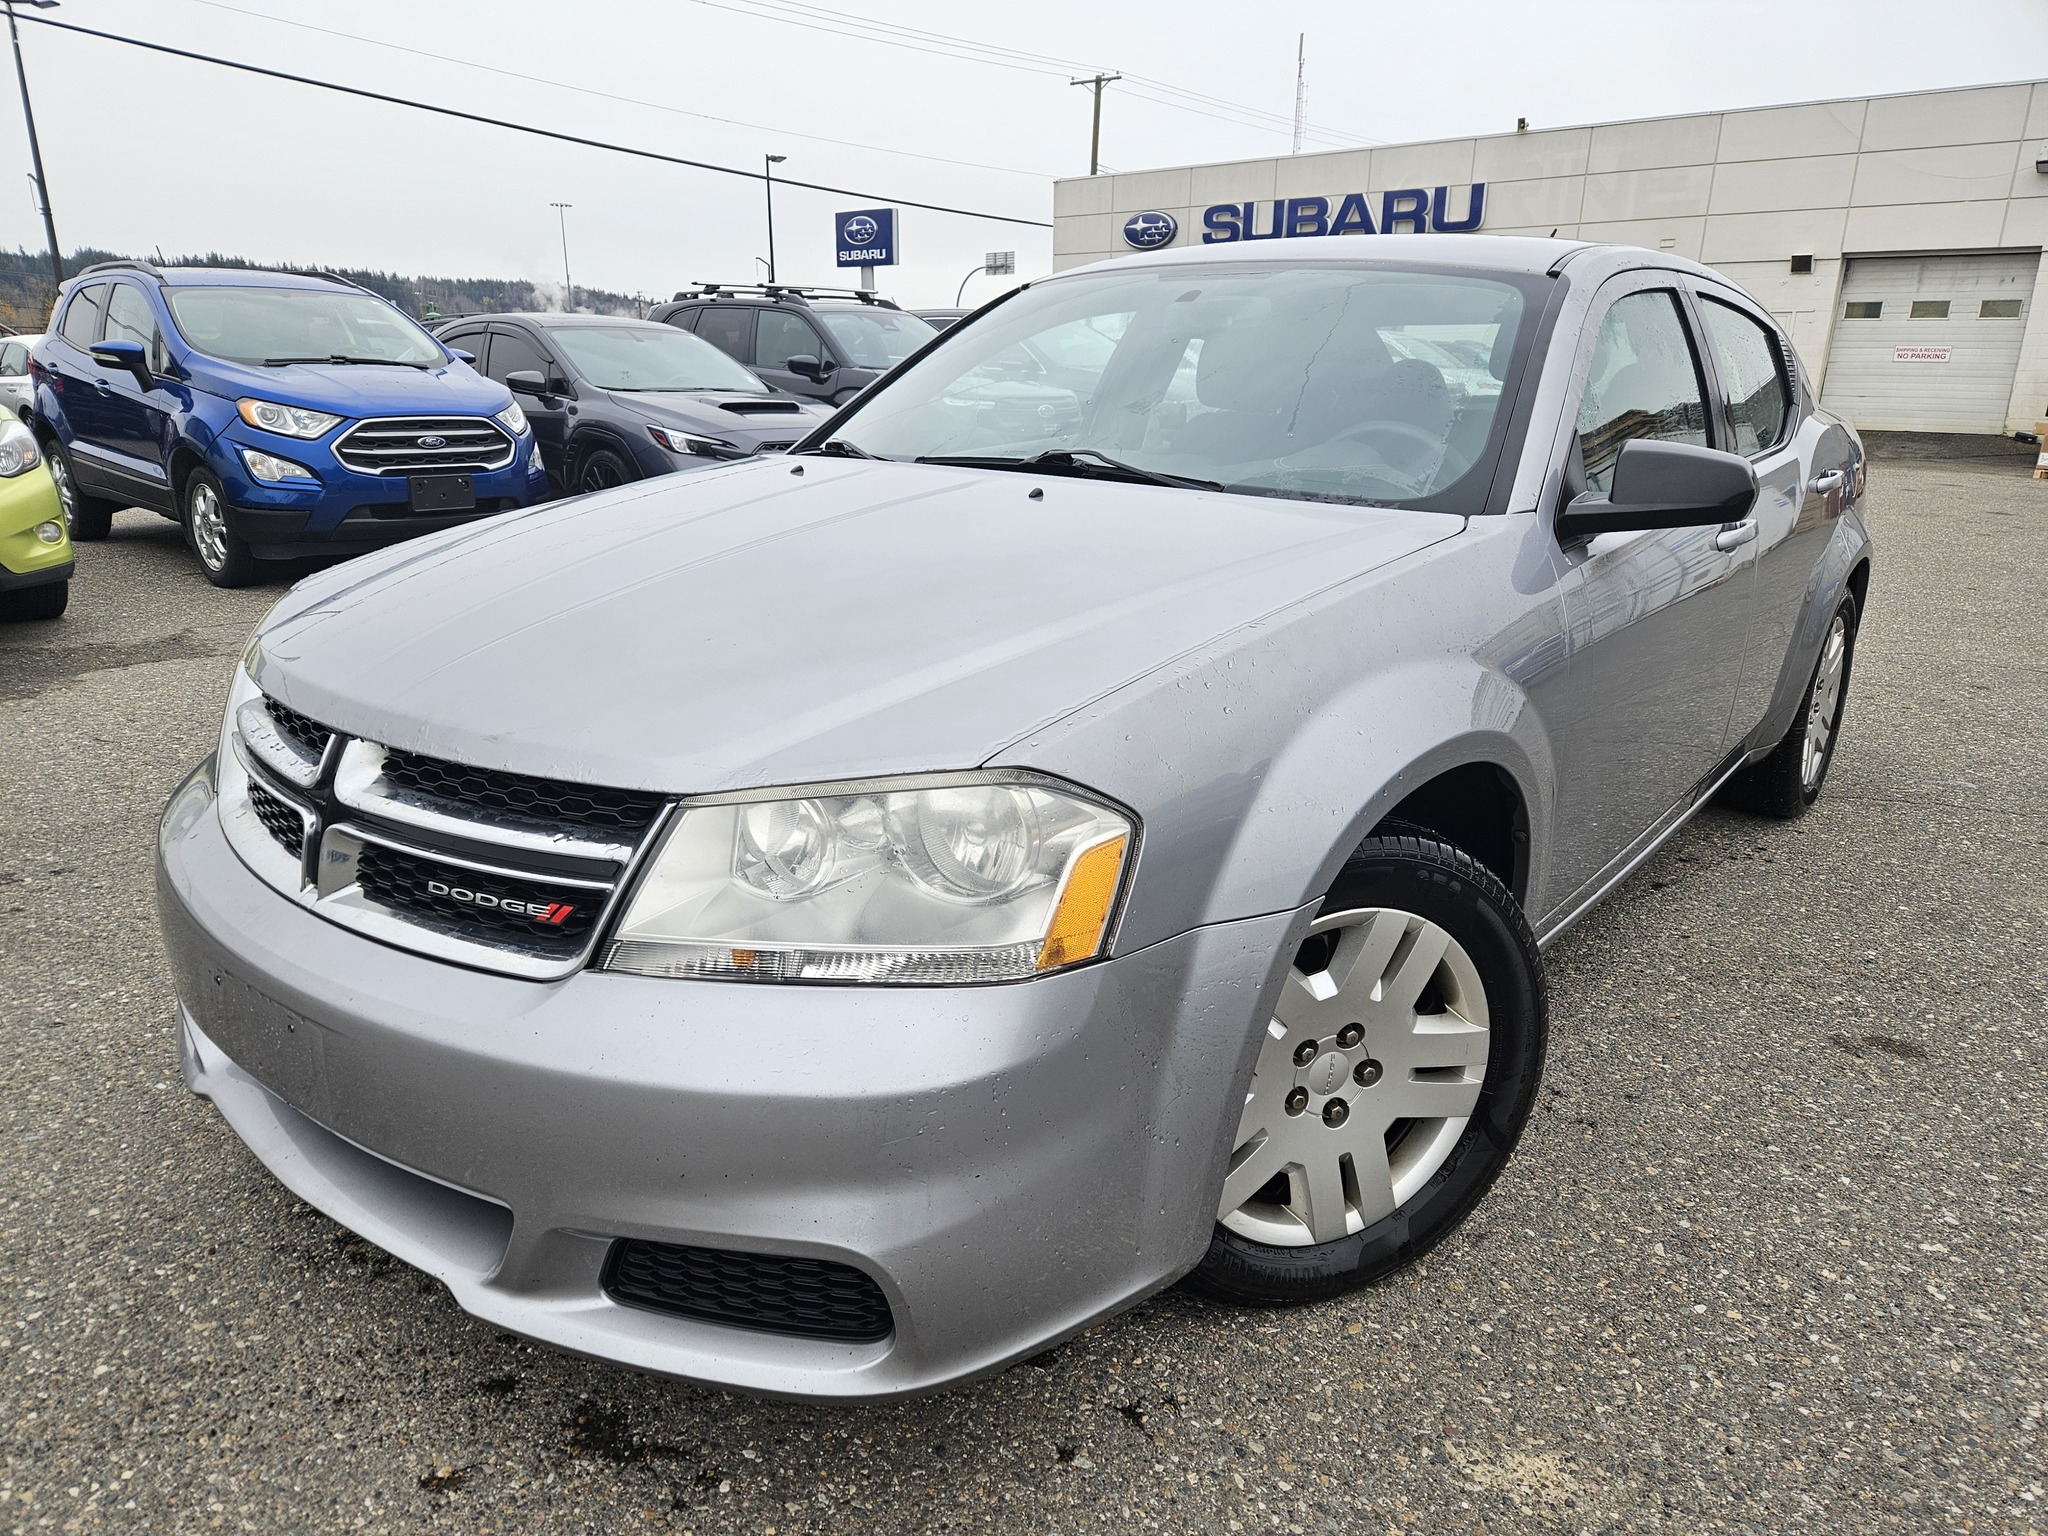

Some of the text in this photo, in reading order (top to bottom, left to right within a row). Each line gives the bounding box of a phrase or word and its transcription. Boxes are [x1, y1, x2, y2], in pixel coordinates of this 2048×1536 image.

[1202, 182, 1486, 244] SUBARU
[839, 249, 887, 261] SUBARU
[428, 881, 551, 917] DODGE
